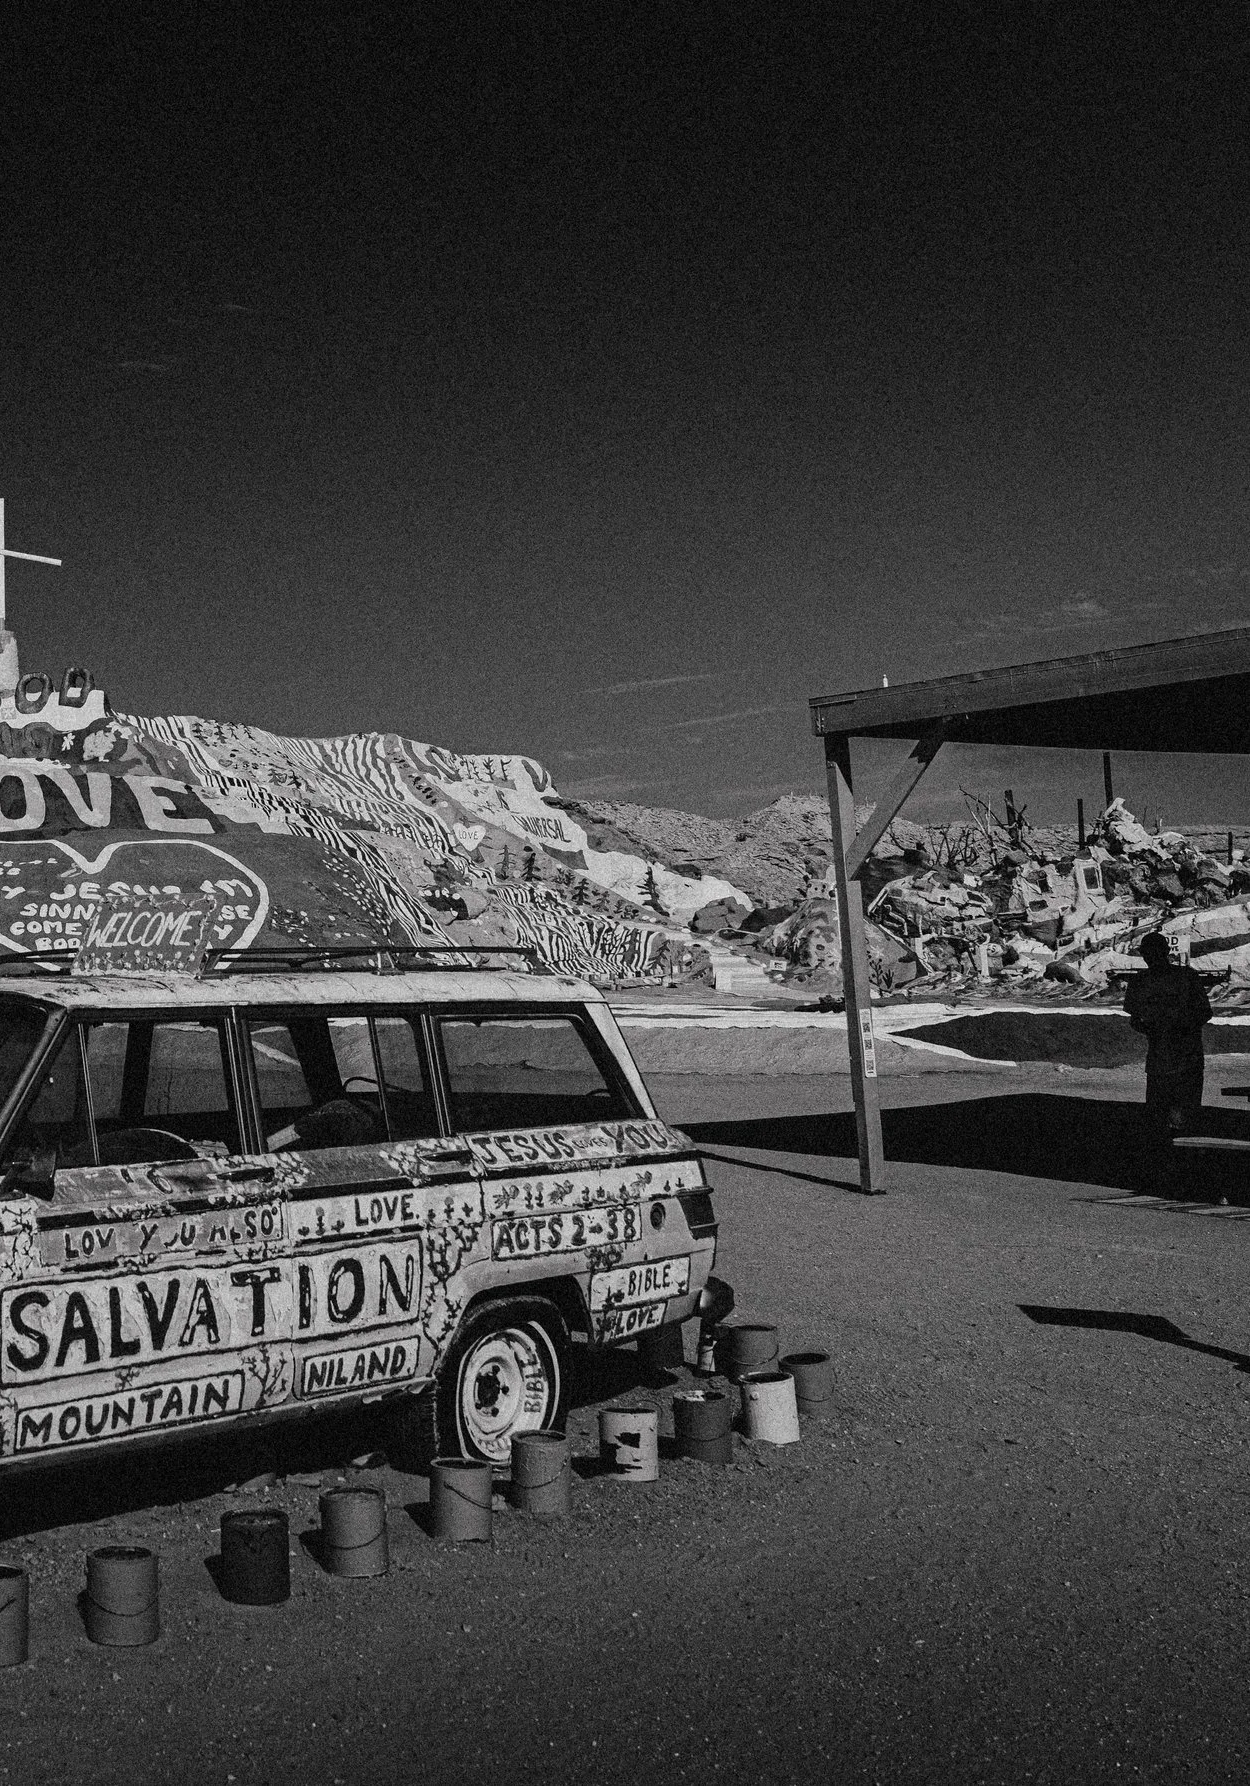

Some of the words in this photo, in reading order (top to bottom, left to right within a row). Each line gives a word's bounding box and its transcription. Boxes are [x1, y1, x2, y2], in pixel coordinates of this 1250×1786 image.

[458, 830, 479, 840] LOVE
[10, 921, 83, 936] COME
[86, 910, 203, 948] WELCOME
[471, 1131, 575, 1165] JESUS
[494, 1214, 563, 1254] ACTS
[7, 1254, 414, 1372] SALVATION
[19, 1378, 230, 1448] MOUNTAIN
